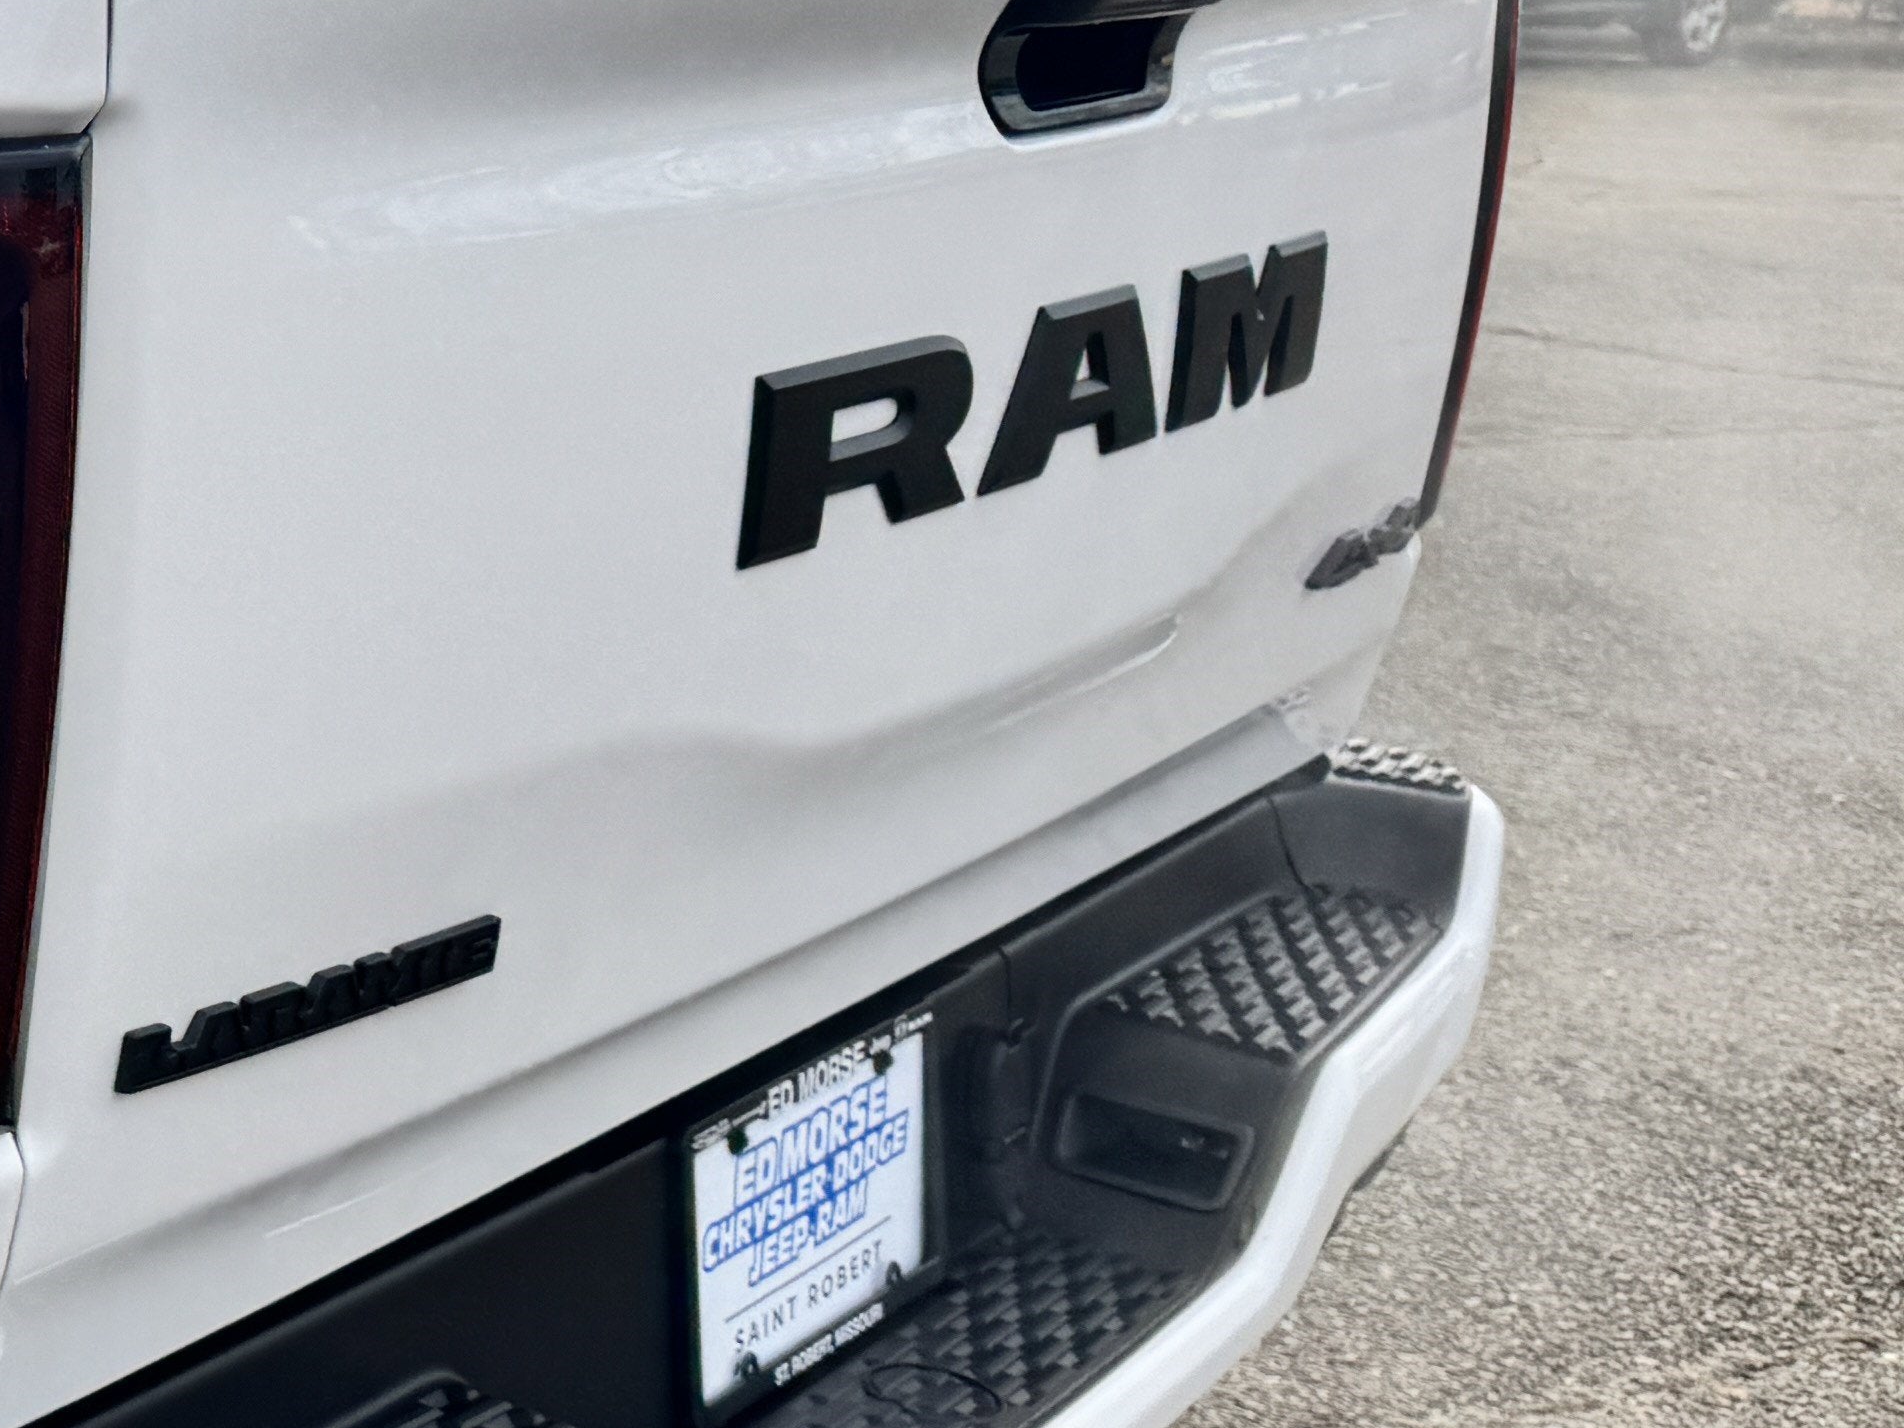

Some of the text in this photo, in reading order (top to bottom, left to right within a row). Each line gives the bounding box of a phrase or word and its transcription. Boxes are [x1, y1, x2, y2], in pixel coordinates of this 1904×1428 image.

[736, 230, 1329, 570] RAM
[767, 1078, 795, 1118] ED
[798, 1040, 867, 1105] MORSE
[703, 1108, 909, 1272] CHRYSLER DODGE
[735, 1076, 888, 1209] ED MORSE
[749, 1177, 868, 1287] JEEP RAM
[735, 1239, 882, 1352] SAINT ROBERT
